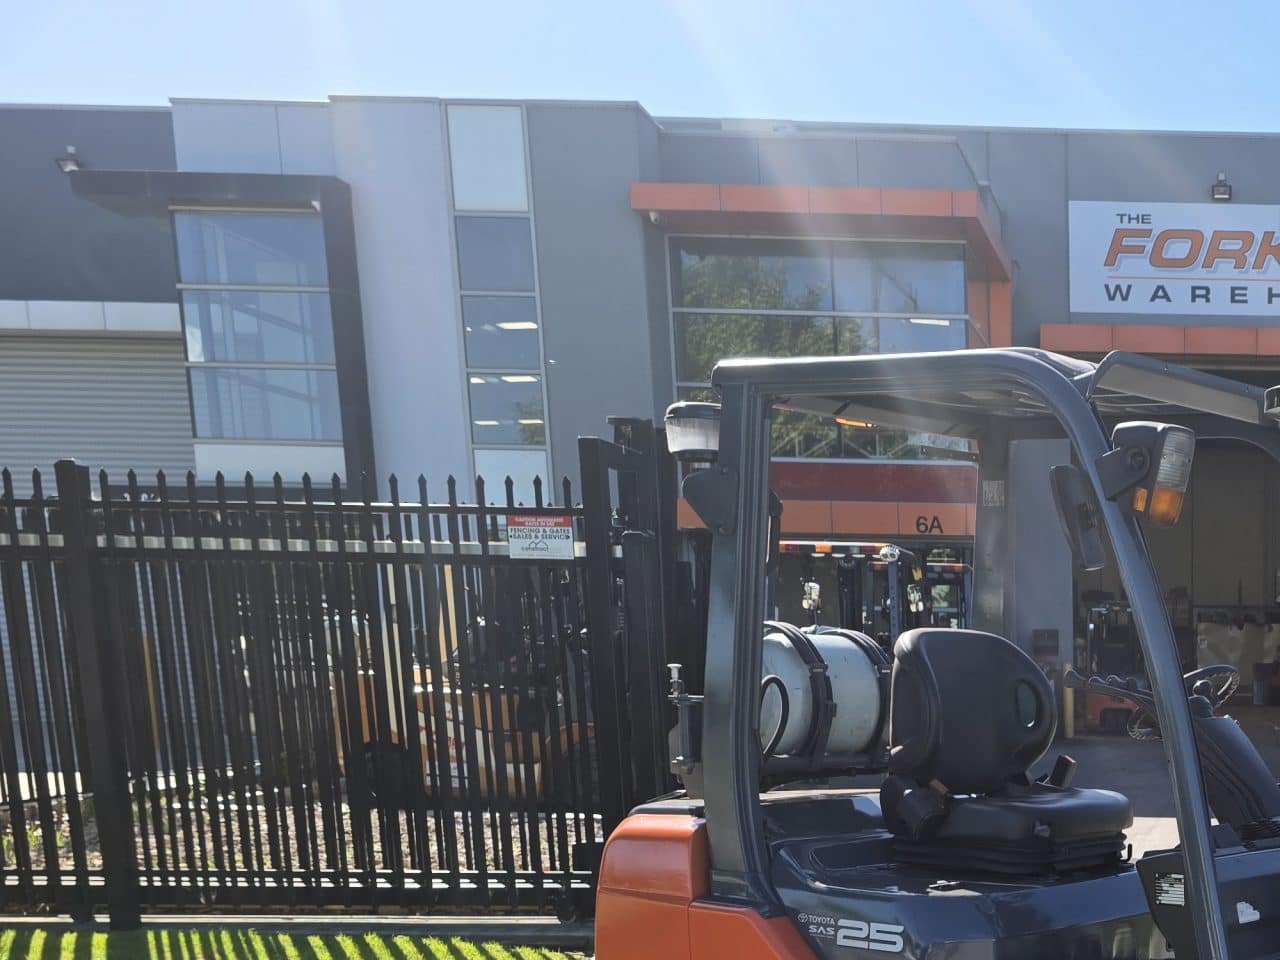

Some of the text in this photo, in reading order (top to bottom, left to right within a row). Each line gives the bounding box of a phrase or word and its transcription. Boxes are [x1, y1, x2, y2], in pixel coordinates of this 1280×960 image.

[1116, 213, 1152, 225] THE
[916, 515, 944, 534] 6A
[808, 914, 836, 925] TOYOTA
[808, 925, 835, 935] SAS
[836, 918, 905, 953] 25
